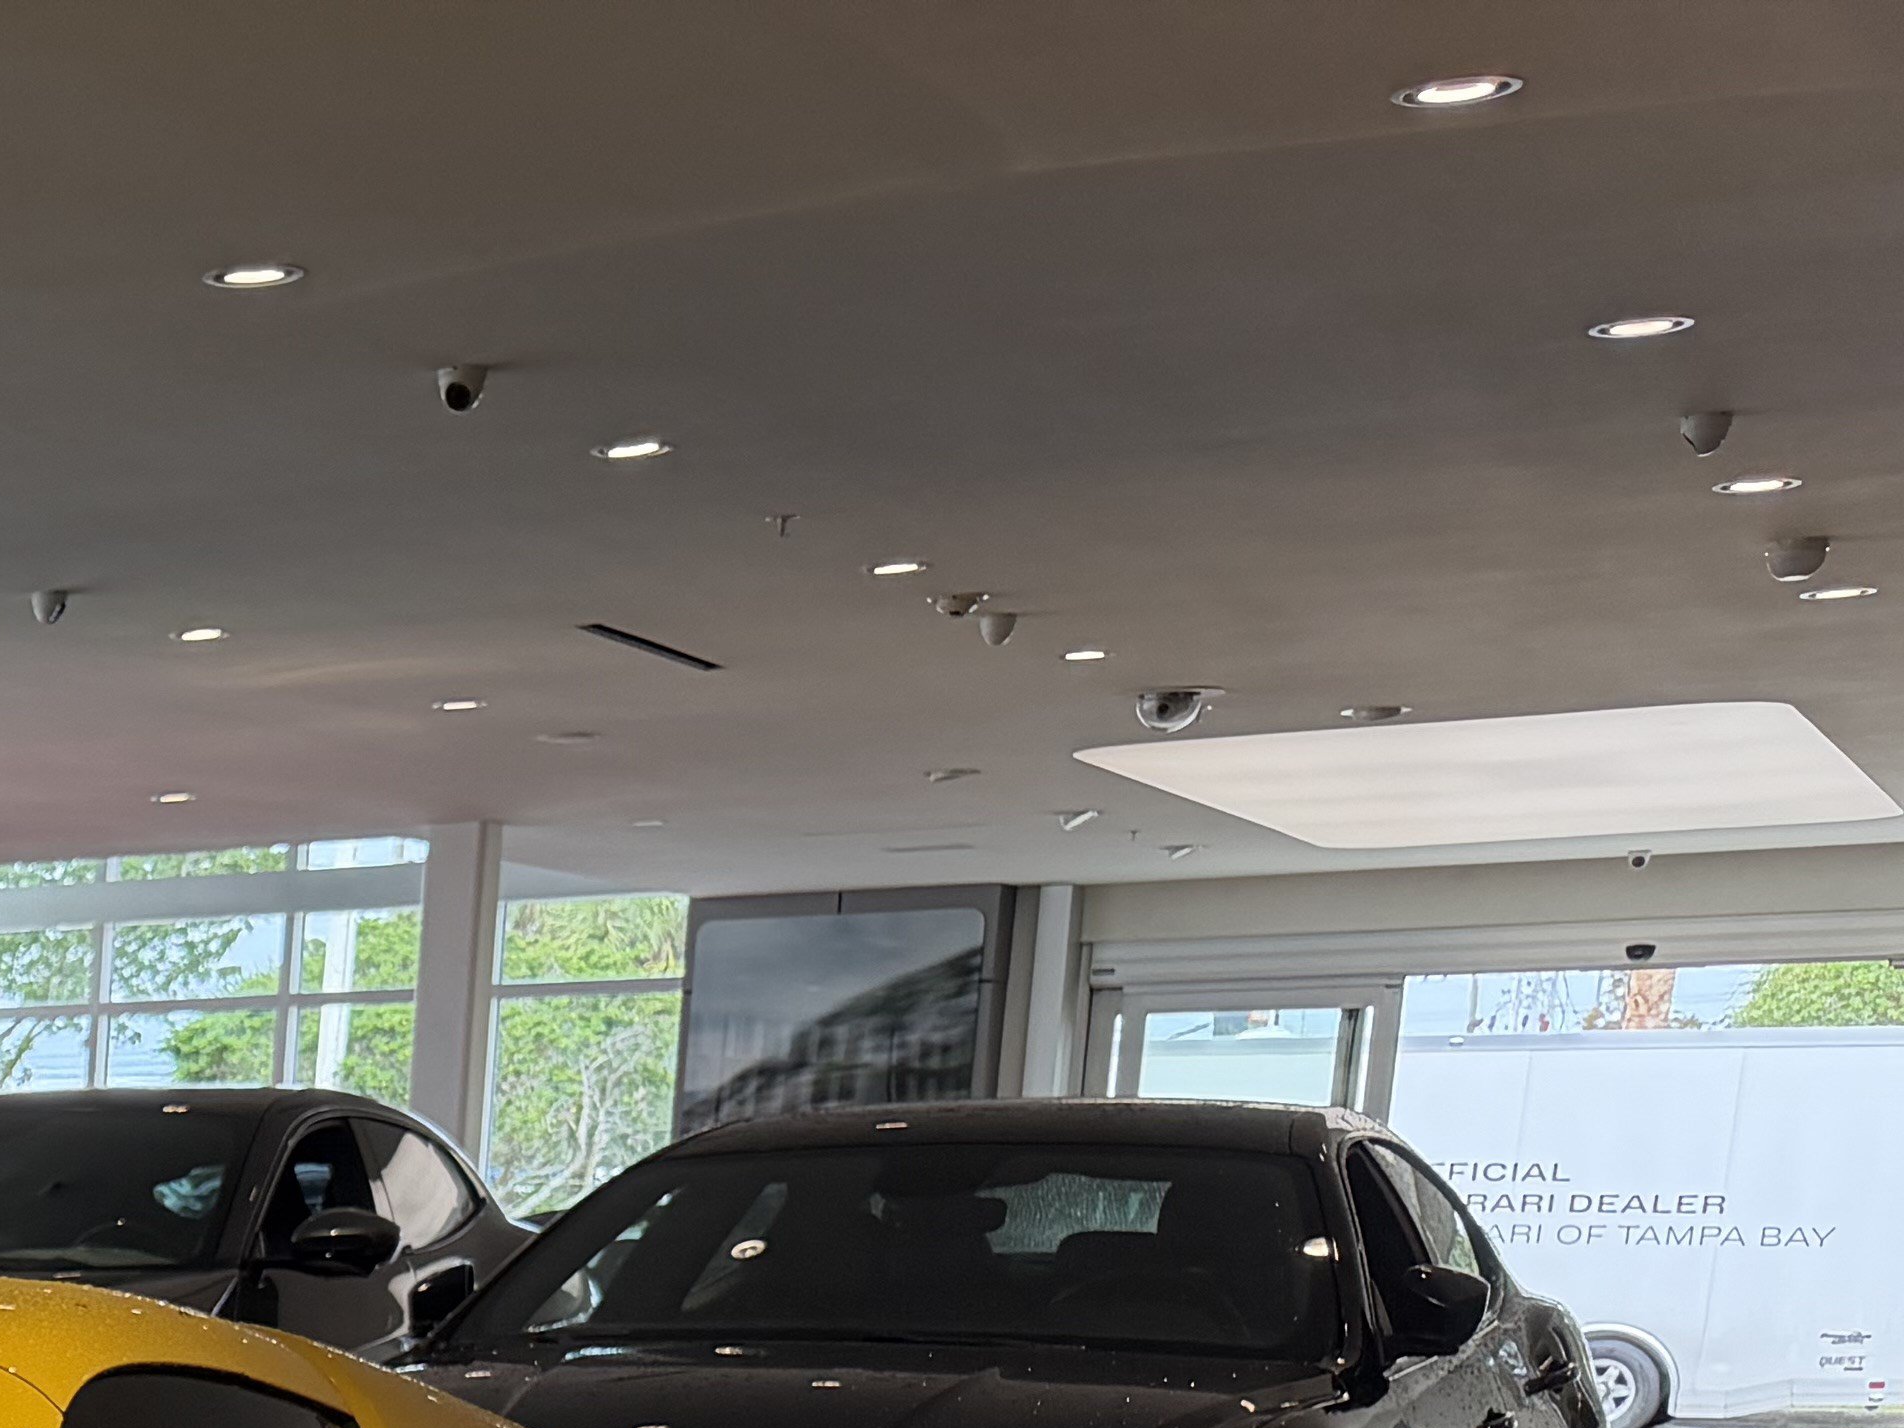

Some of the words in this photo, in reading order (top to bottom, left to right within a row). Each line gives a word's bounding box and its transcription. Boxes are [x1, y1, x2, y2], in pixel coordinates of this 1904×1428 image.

[1431, 1162, 1570, 1182] FICIAL
[1466, 1193, 1554, 1213] RARI
[1568, 1194, 1727, 1215] DEALER
[1556, 1223, 1608, 1246] OF
[1617, 1225, 1746, 1247] TAMPA
[1759, 1226, 1837, 1248] BAY
[1819, 1356, 1866, 1367] QUEST
